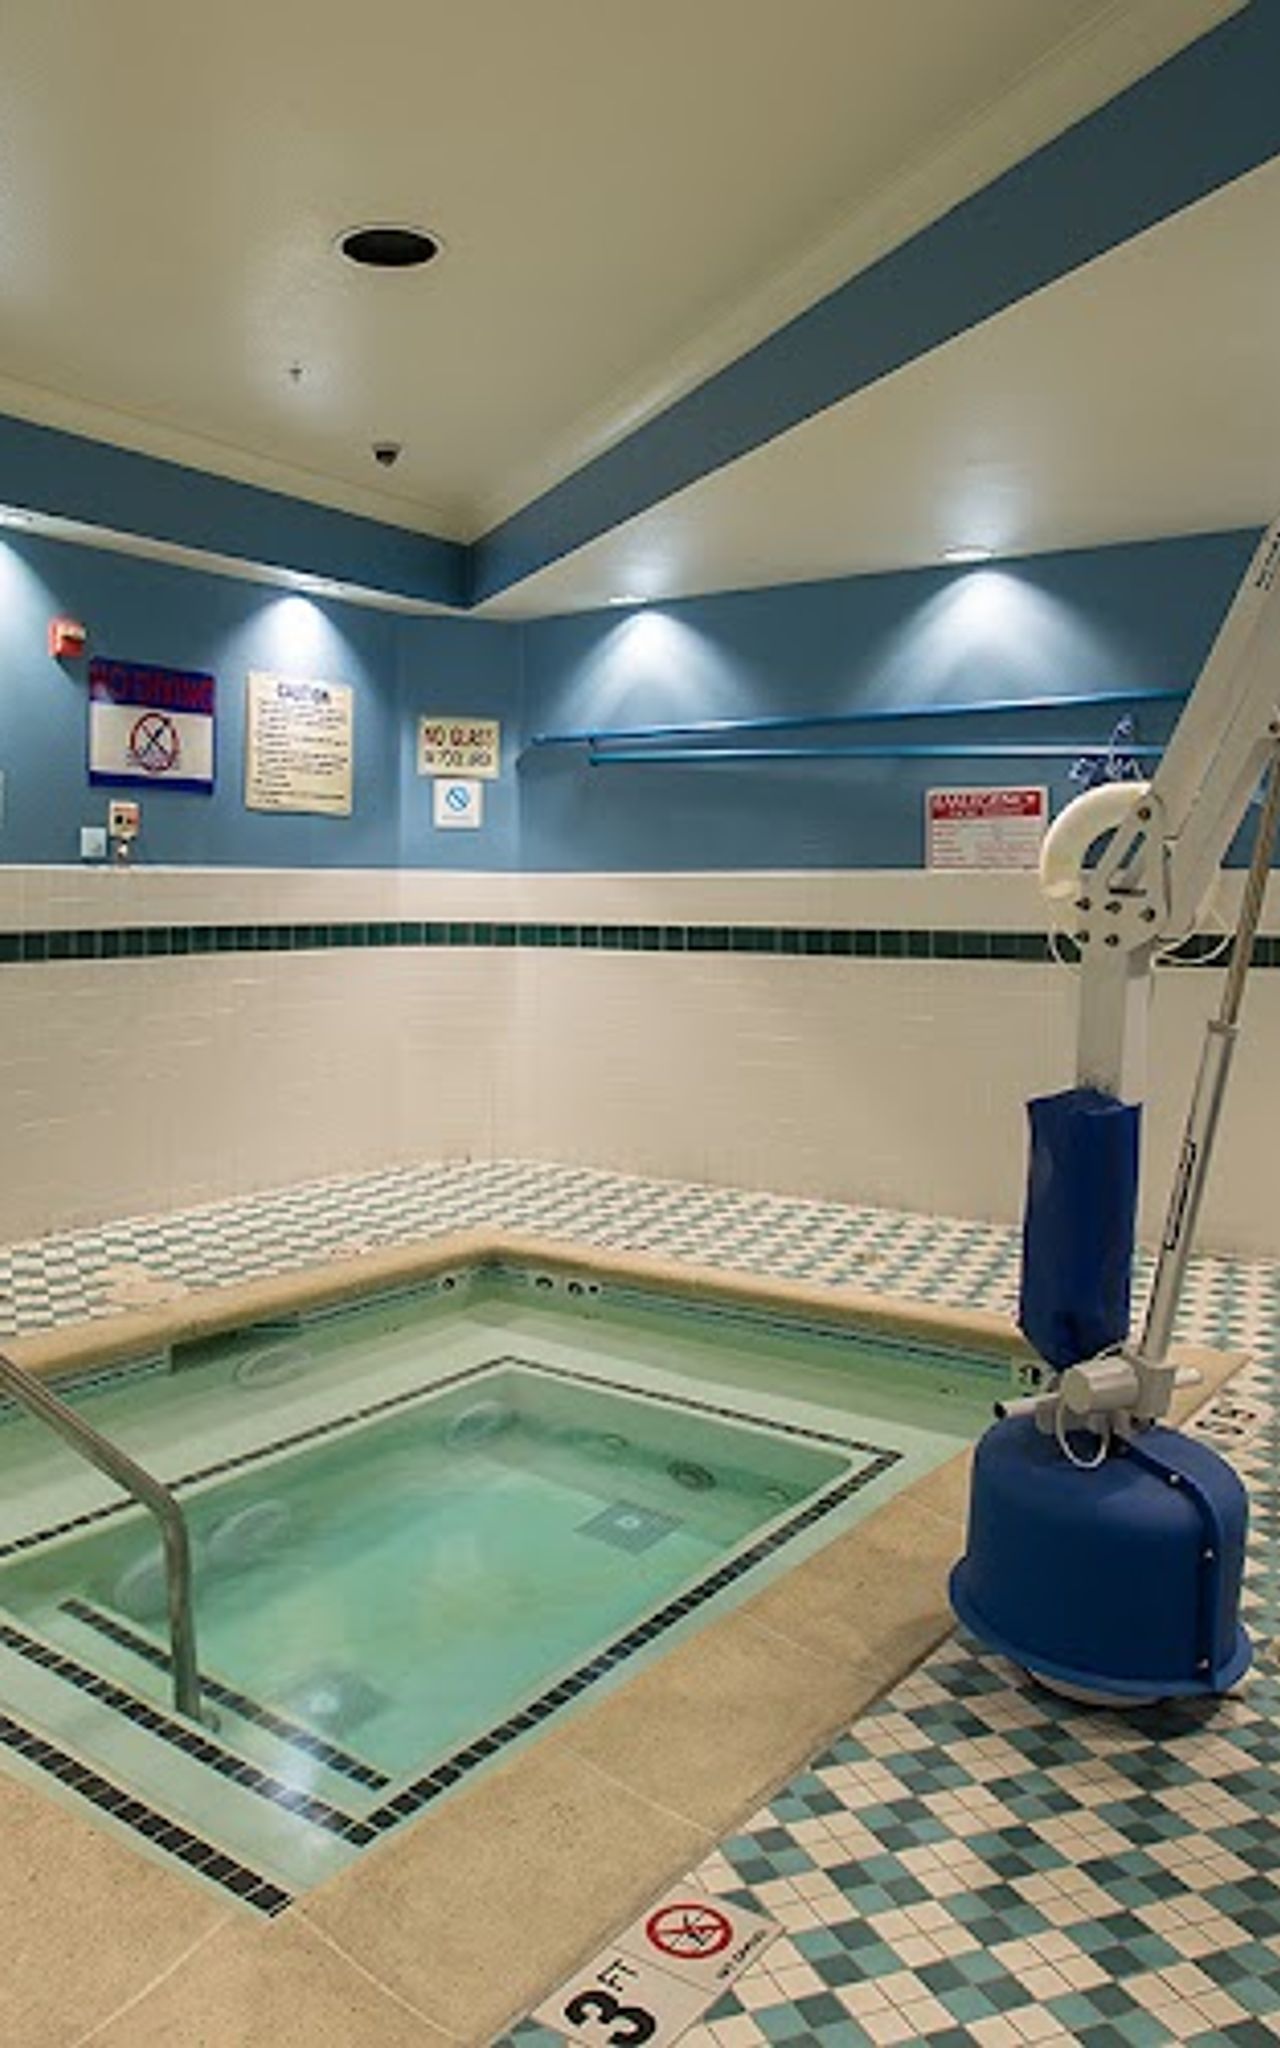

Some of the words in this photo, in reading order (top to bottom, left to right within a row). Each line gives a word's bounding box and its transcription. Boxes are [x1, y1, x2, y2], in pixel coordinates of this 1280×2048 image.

[424, 726, 446, 746] NO
[450, 727, 494, 747] GLASS
[597, 1958, 638, 1992] FT
[564, 1990, 656, 2048] 3
